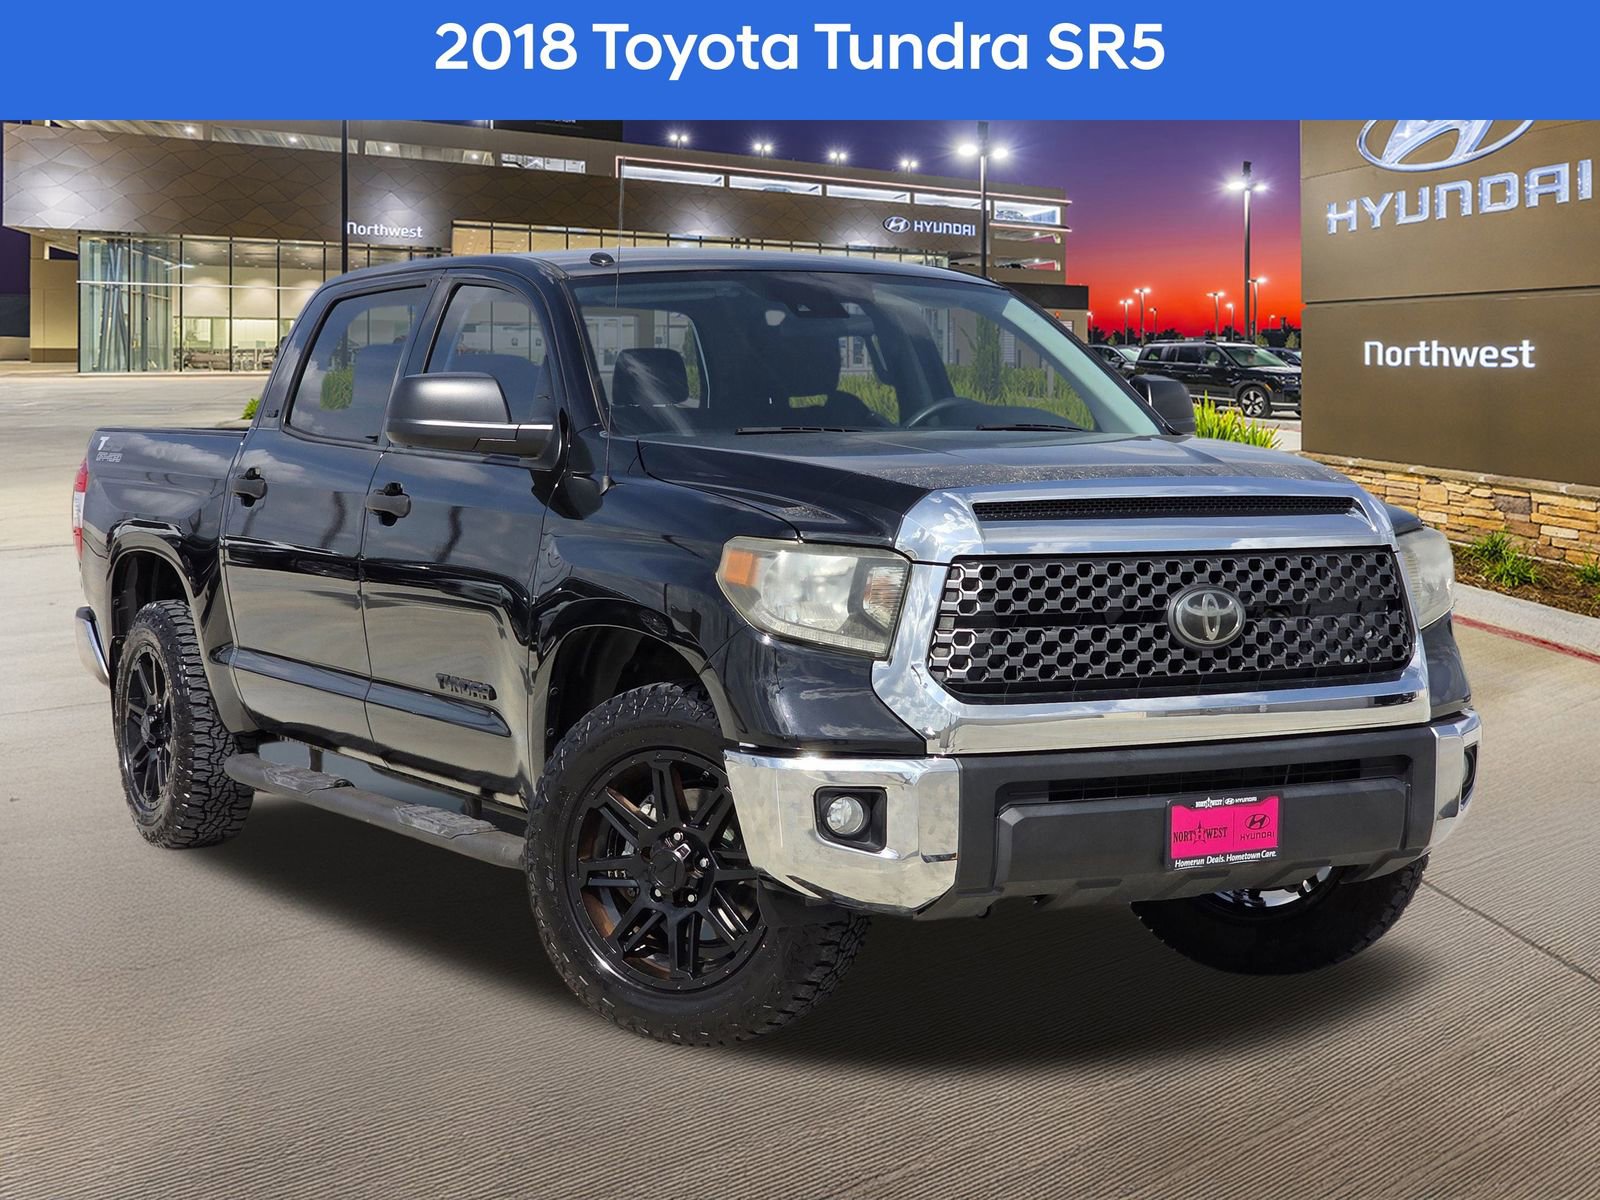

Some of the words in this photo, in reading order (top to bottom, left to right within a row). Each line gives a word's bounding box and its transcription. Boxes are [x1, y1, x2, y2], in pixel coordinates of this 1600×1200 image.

[1327, 159, 1593, 235] HYUNDAI
[347, 221, 423, 238] Northwest
[914, 220, 976, 236] HYUNDAI
[1364, 340, 1536, 368] Northwest
[1240, 831, 1275, 841] HYUNDAI
[1175, 858, 1204, 868] Homerun
[1206, 854, 1225, 865] Deals.
[1226, 851, 1260, 862] Hometown
